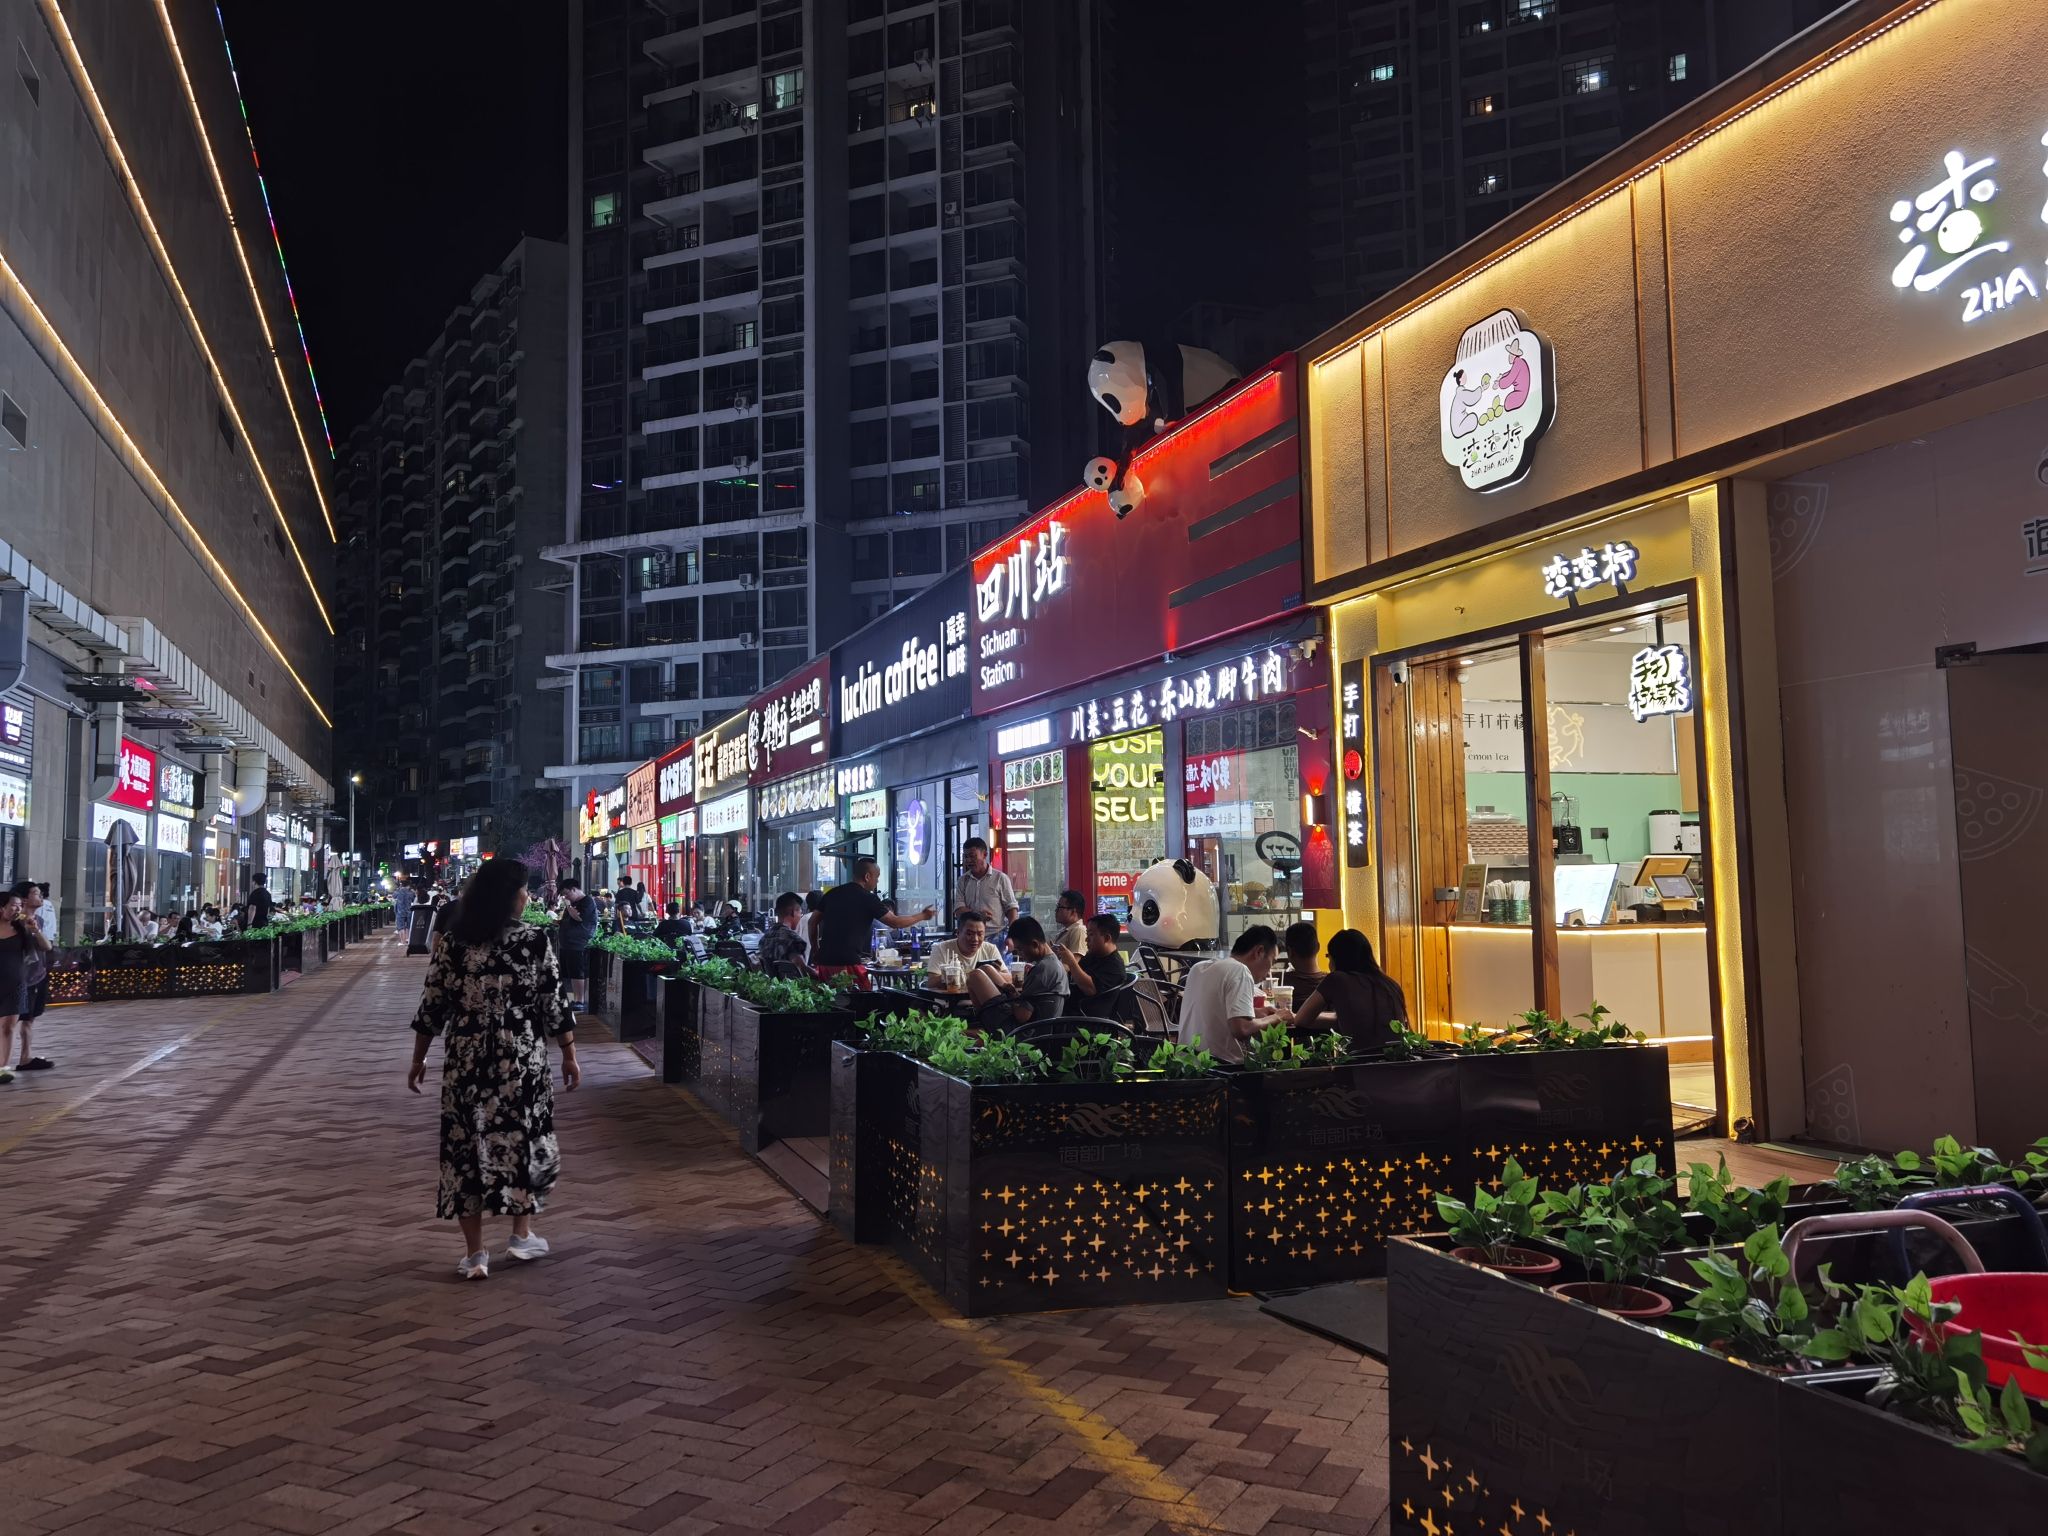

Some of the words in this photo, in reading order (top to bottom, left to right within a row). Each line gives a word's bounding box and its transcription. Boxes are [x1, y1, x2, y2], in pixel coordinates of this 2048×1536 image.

[1960, 267, 2039, 322] ZHA
[1462, 421, 1524, 469] 渣渣柠
[976, 520, 1066, 622] 四川站
[1542, 543, 1637, 598] 渣渣柠
[946, 611, 966, 646] 瑞幸
[980, 627, 1017, 659] Sichuan
[841, 660, 881, 724] luckin
[884, 636, 938, 705] coffee
[946, 643, 966, 678] 咖啡
[980, 660, 1014, 690] Station
[1094, 796, 1165, 822] SELF
